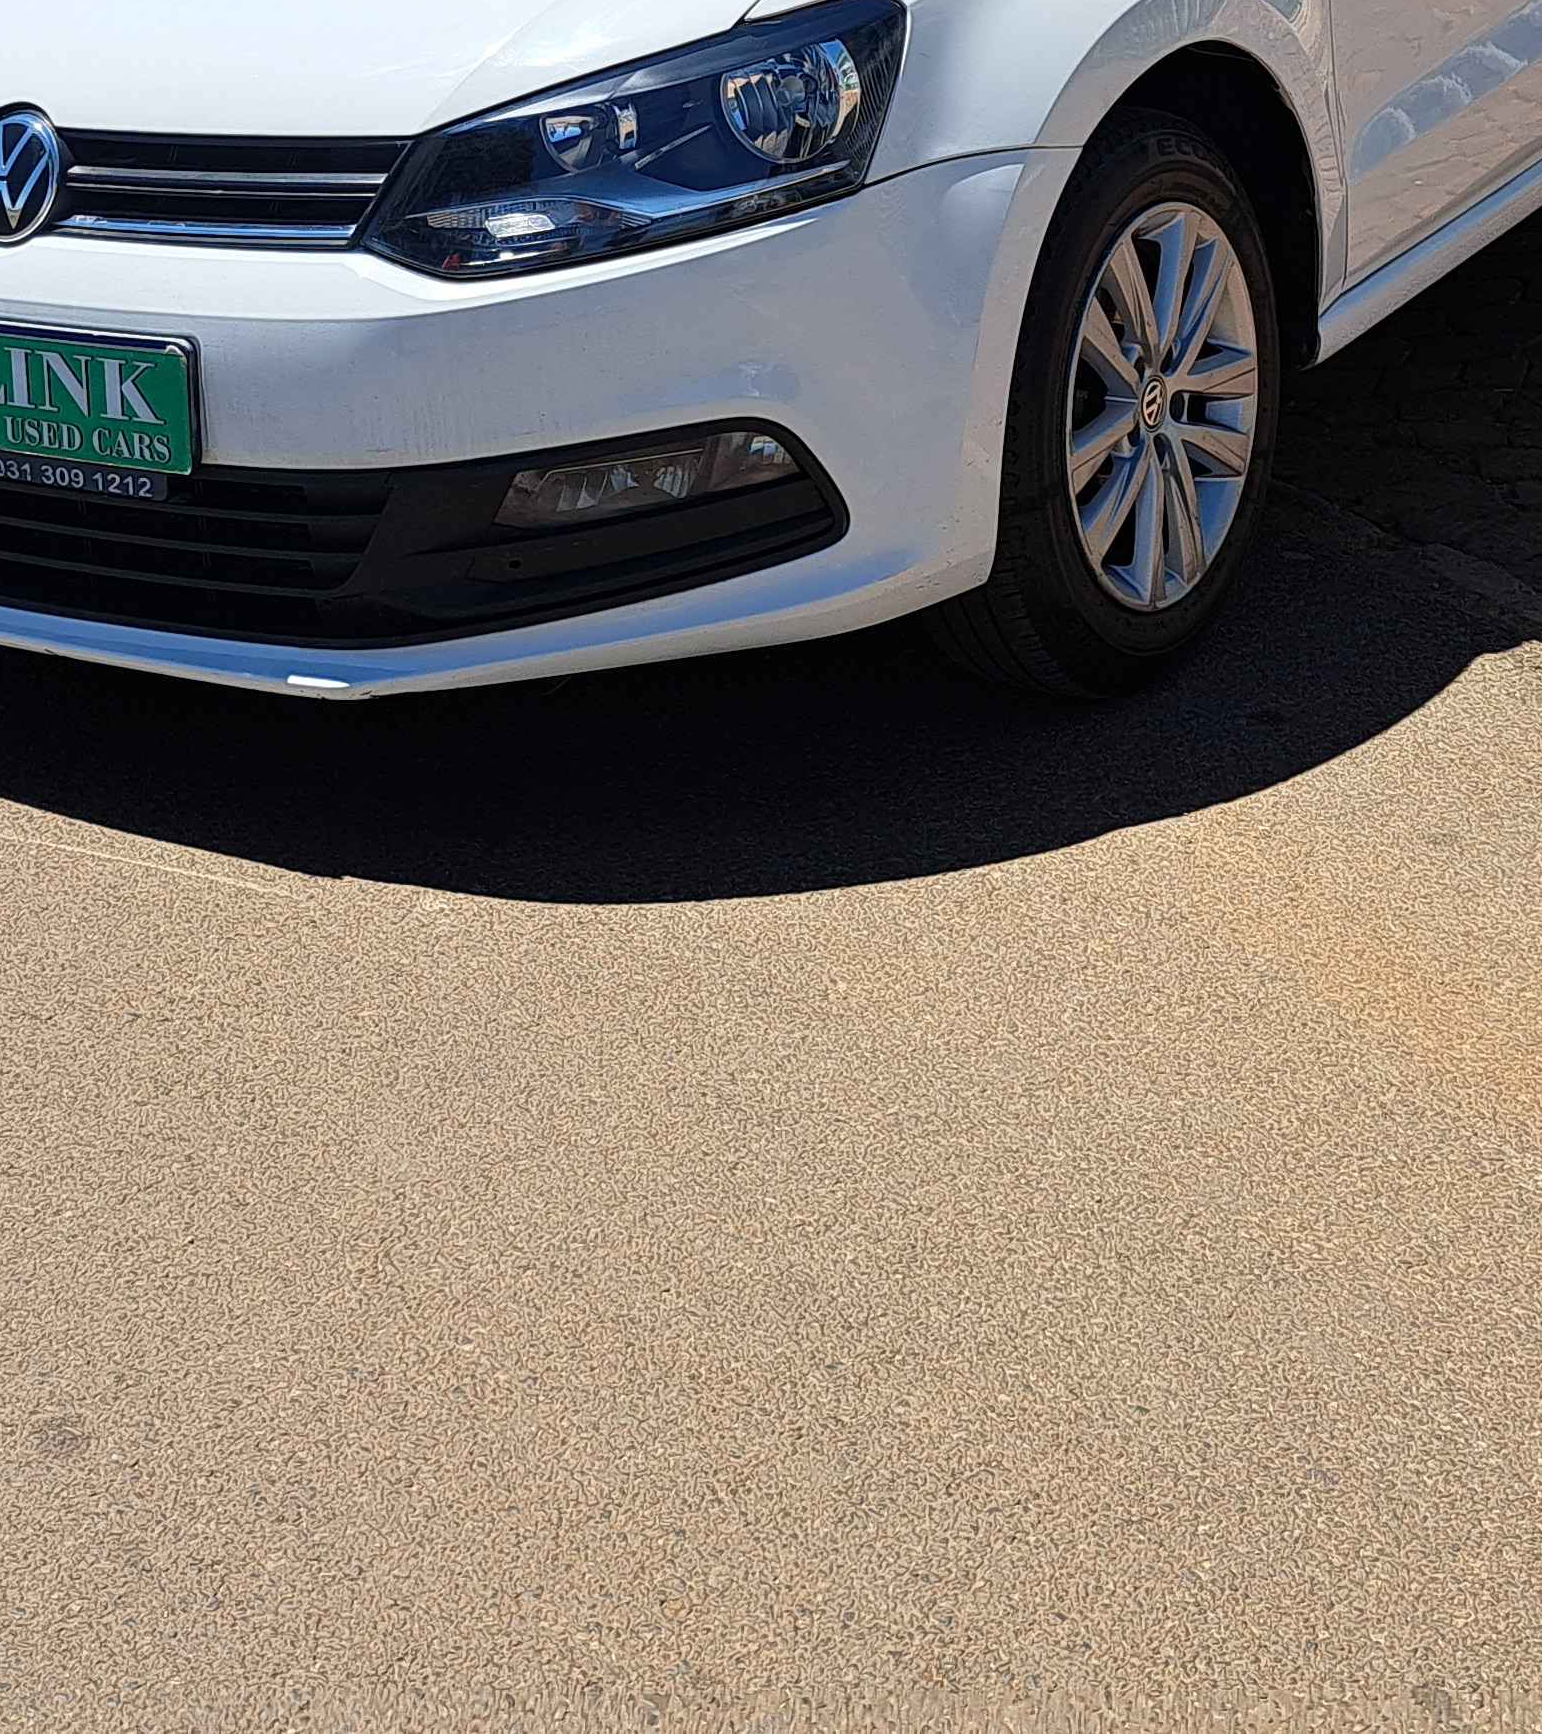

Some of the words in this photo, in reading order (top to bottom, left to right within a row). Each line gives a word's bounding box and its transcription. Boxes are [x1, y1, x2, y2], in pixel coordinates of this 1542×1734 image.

[5, 417, 83, 452] USED
[92, 428, 172, 465] CARS
[41, 465, 85, 489] 309
[92, 472, 154, 499] 1212
